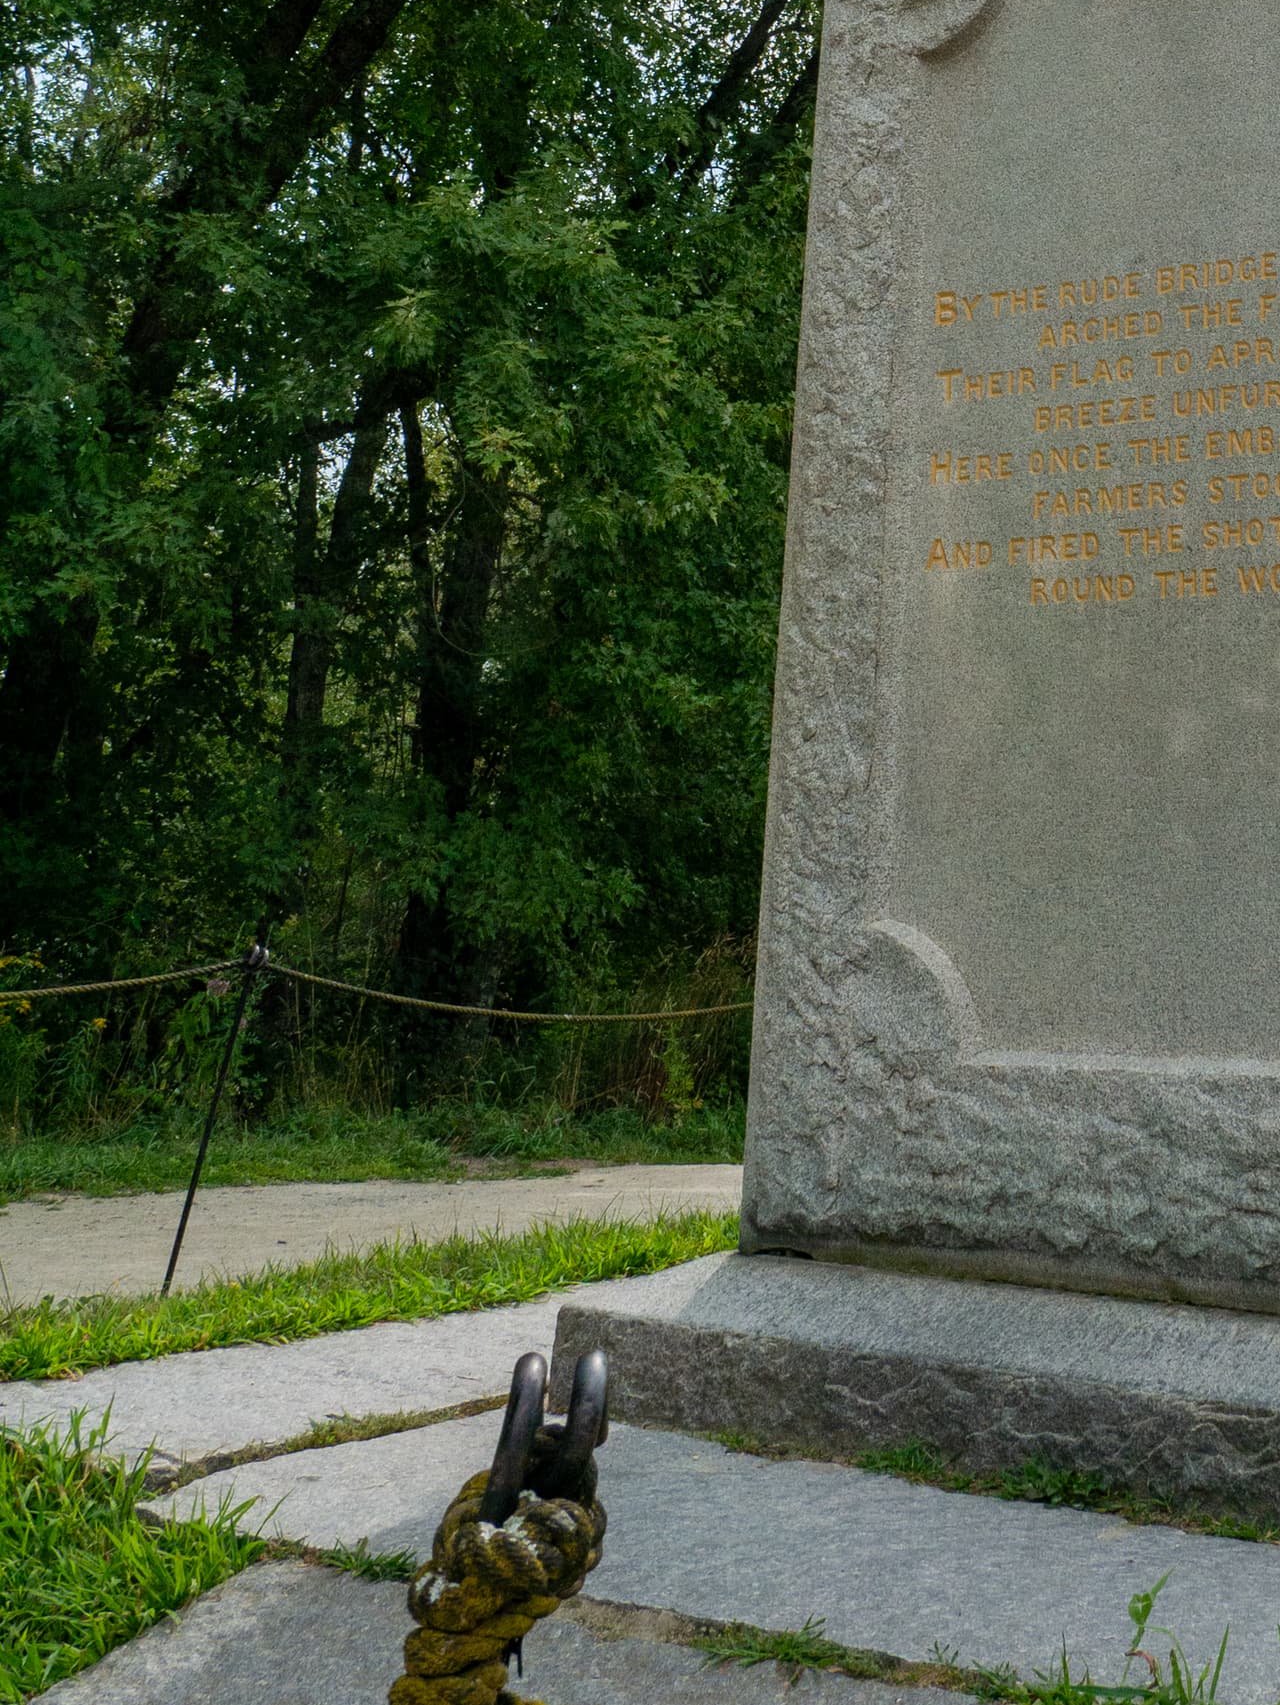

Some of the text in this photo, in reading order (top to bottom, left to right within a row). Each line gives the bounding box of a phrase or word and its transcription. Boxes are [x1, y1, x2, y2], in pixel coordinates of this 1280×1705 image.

[986, 285, 1048, 318] THE
[1058, 271, 1142, 309] RUDE
[1156, 251, 1278, 295] BRIDGE
[1036, 309, 1164, 353] ARCHED
[1178, 298, 1244, 332] THE
[1049, 355, 1135, 391] FLAG
[1150, 348, 1192, 378] TO
[1033, 395, 1157, 434] BREEZE
[1028, 442, 1113, 476] ONCE
[1128, 434, 1191, 467] THE
[1031, 479, 1189, 521] FARMERS
[1006, 530, 1100, 567] FIRED
[1117, 523, 1185, 558] THE
[1029, 574, 1136, 607] ROUND
[1154, 567, 1218, 600] THE
